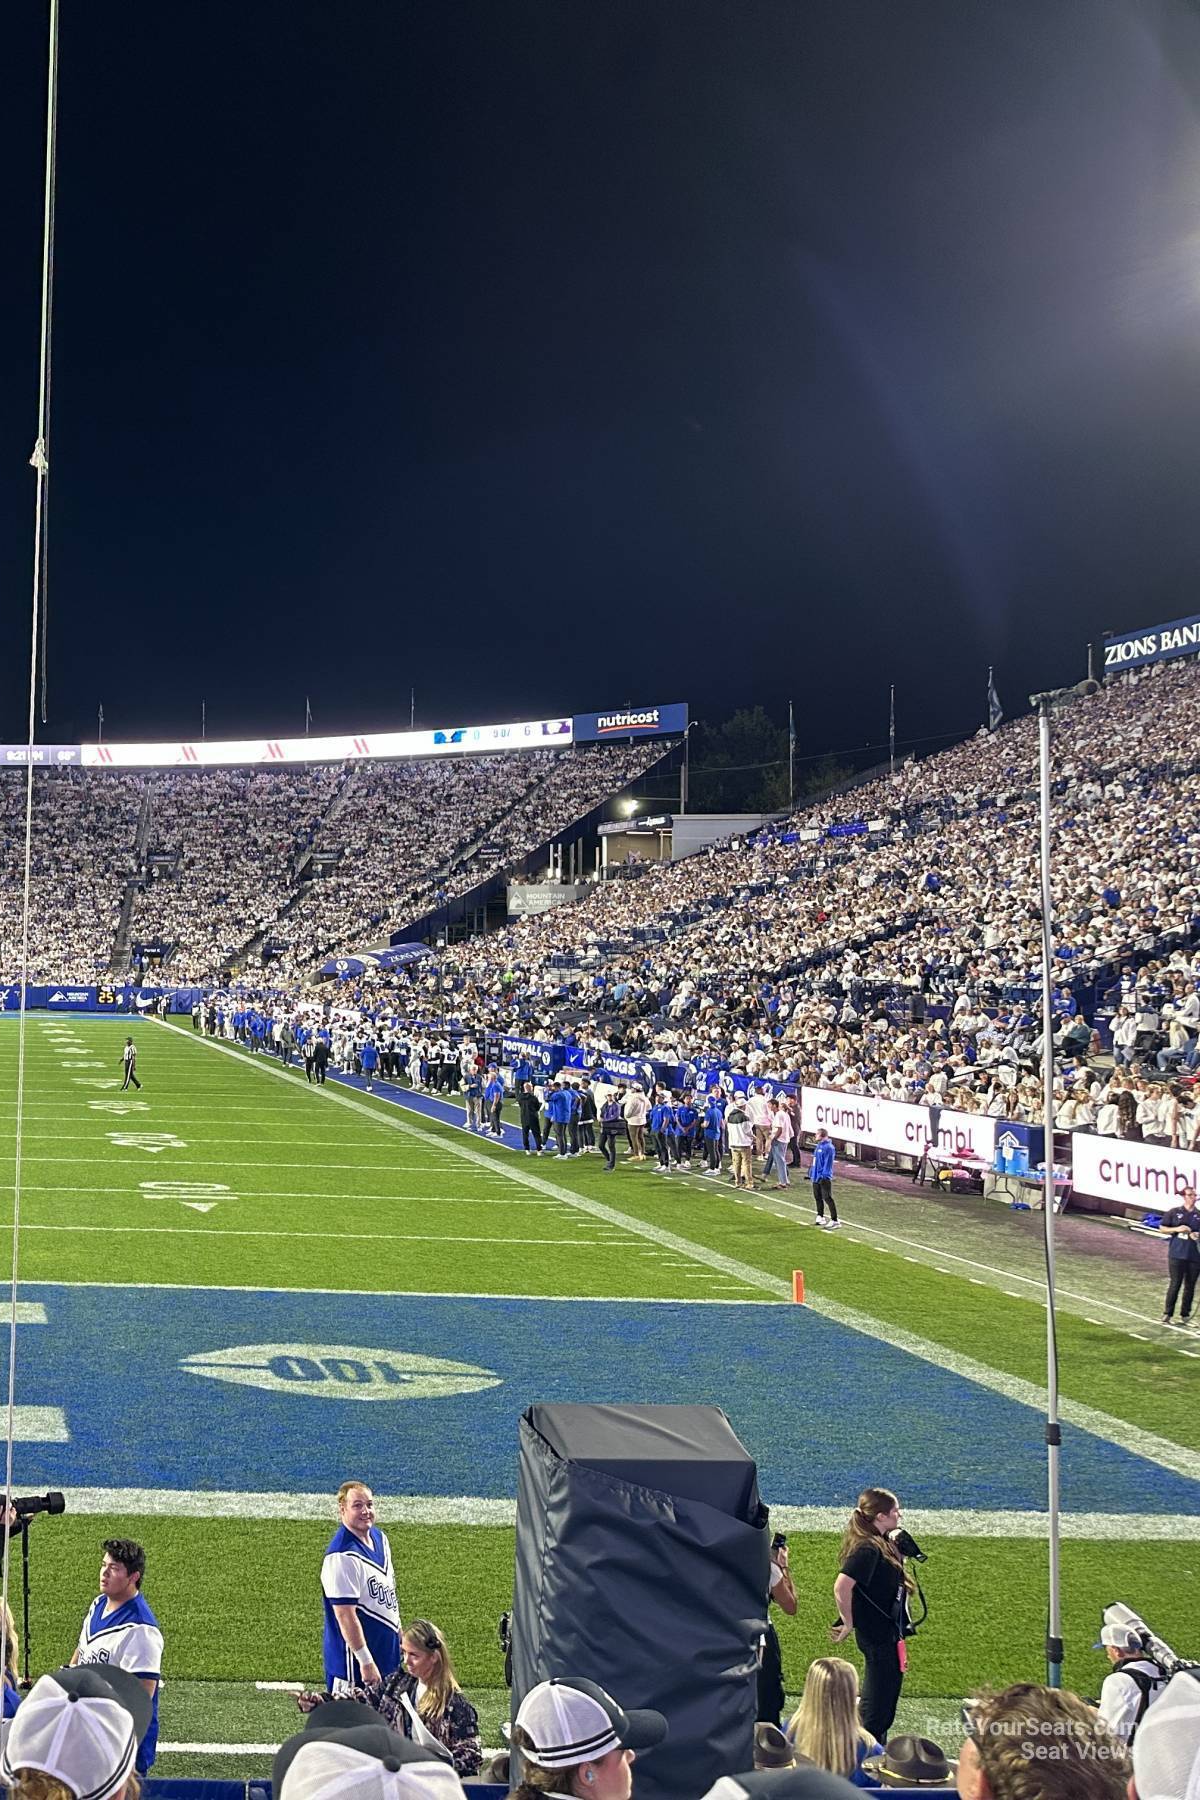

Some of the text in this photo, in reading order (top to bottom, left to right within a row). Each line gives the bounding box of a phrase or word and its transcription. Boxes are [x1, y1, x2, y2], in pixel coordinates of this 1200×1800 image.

[1105, 635, 1157, 665] ZIONS
[598, 710, 659, 728] nutricost
[99, 992, 114, 1003] 25
[502, 1040, 541, 1057] FOOTBALL
[816, 1104, 872, 1132] crumbl
[905, 1121, 972, 1152] crumbl
[1100, 1158, 1198, 1196] crumbl
